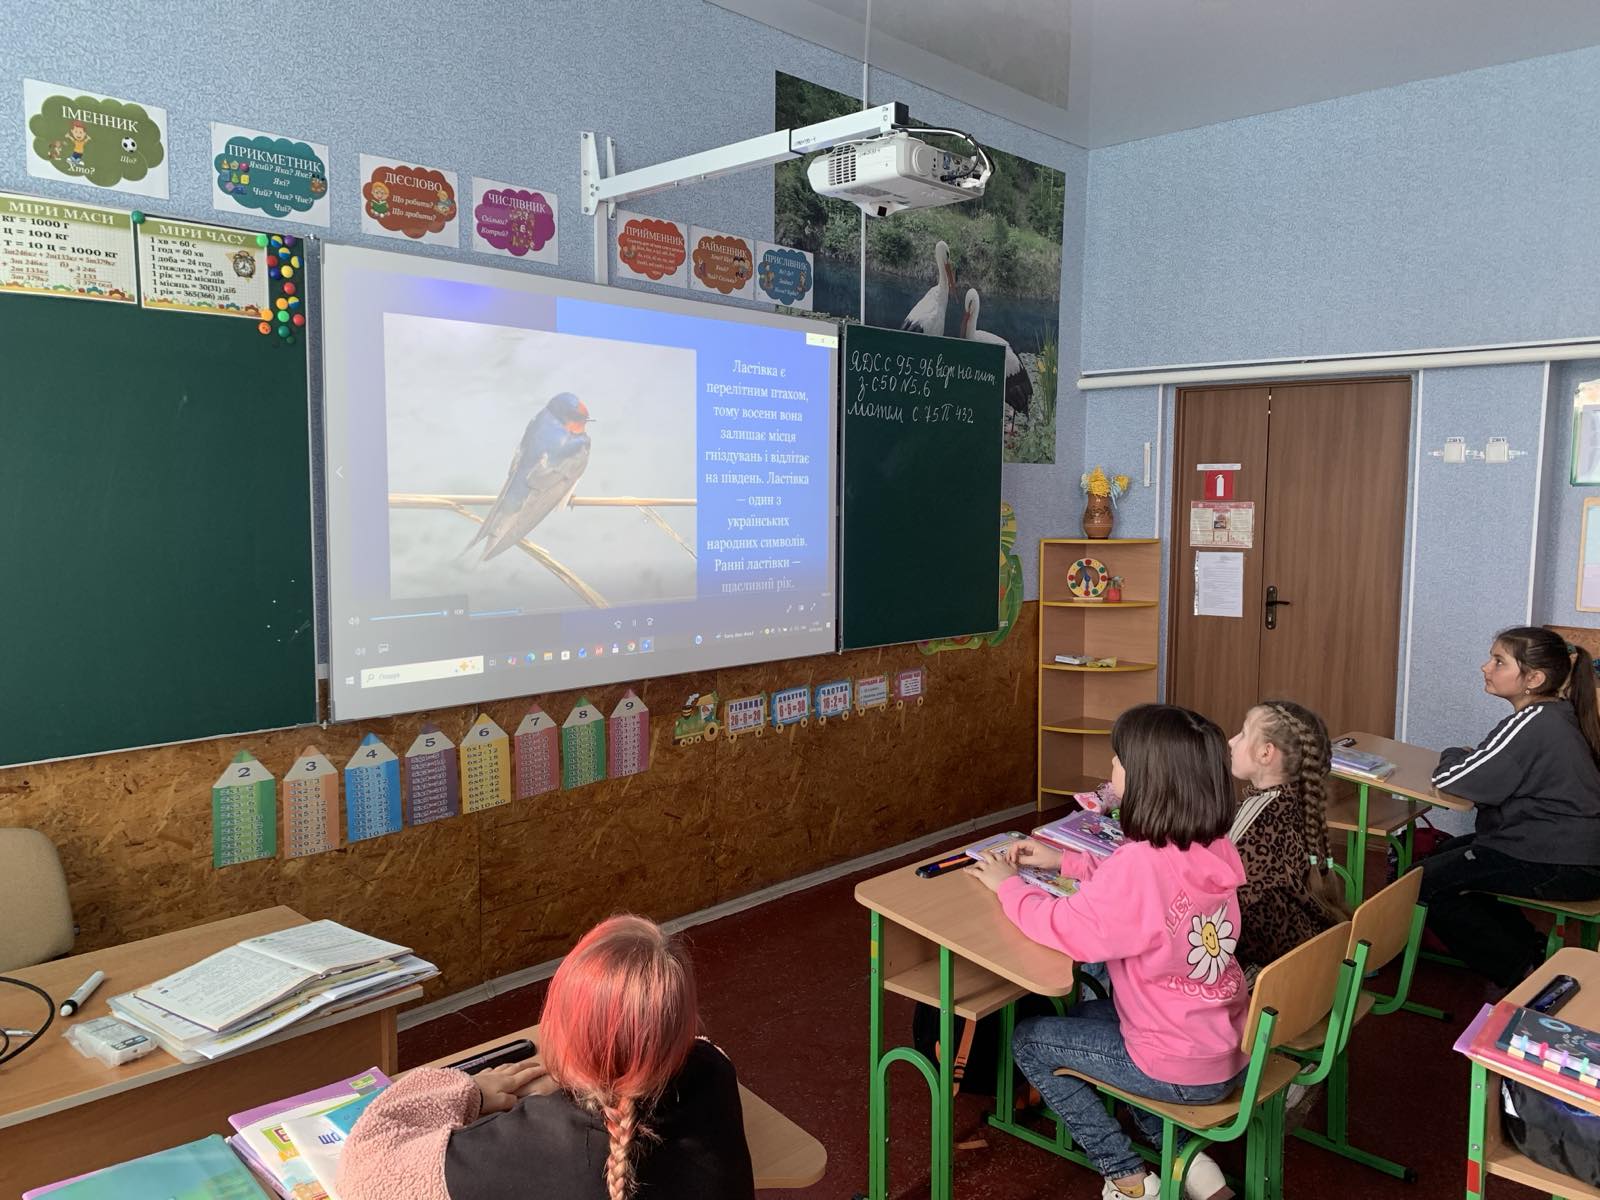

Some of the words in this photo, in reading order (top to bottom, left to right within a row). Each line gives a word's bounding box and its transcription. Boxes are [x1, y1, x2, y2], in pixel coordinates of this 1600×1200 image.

[62, 105, 138, 133] ІМЕННИК
[120, 156, 137, 164] Що?
[228, 144, 321, 173] ПРИКМЕТНИК
[68, 163, 96, 175] Хто?
[249, 160, 274, 172] Який?
[274, 166, 294, 176] Яка?
[294, 169, 312, 179] Яке?
[273, 177, 290, 186] Які?
[384, 172, 442, 192] ДІЄСЛОВО
[252, 186, 272, 198] Чий?
[488, 192, 546, 214] ЧИСЛІВНИК
[9, 201, 58, 217] МІРИ
[64, 208, 114, 225] МАСИ
[31, 218, 60, 228] 1000
[4, 228, 13, 236] ц
[28, 230, 52, 238] 100
[160, 224, 202, 239] МІРИ
[206, 231, 246, 244] ЧАСУ
[626, 226, 684, 246] ПРИЙМЕННИК
[28, 242, 43, 250] 10
[47, 244, 56, 252] ц
[72, 246, 101, 256] 1000
[150, 236, 155, 244] 1
[180, 240, 190, 248] 60
[700, 240, 748, 258] ЗАЙМЕННИК
[188, 258, 196, 266] 24
[765, 254, 808, 271] ПРИСЛІВНИК
[732, 359, 778, 376] Ластівка
[780, 366, 786, 377] є
[957, 364, 972, 380] на
[706, 381, 768, 400] перелітним
[770, 388, 808, 403] птахом,
[713, 406, 740, 420] тому
[742, 406, 778, 421] восени
[780, 410, 802, 422] вона
[720, 428, 766, 442] залишає
[768, 430, 796, 444] місця
[705, 451, 763, 466] гніздувань
[764, 452, 769, 463] і
[770, 452, 810, 466] відлітає
[706, 472, 718, 484] на
[720, 471, 765, 486] південь.
[766, 472, 810, 486] Ластівка
[748, 494, 774, 508] один
[776, 496, 782, 506] з
[727, 514, 790, 530] українських
[707, 538, 758, 553] народних
[760, 536, 808, 550] символів.
[715, 558, 744, 572] Ранні
[746, 556, 790, 571] ластівки
[722, 579, 774, 595] щасливий
[776, 577, 795, 593] рік.
[822, 685, 848, 696] ЧАСТКА
[625, 702, 634, 710] 9
[530, 716, 540, 726] 7
[579, 710, 588, 718] 8
[478, 728, 490, 737] 6
[425, 738, 436, 747] 5
[366, 750, 378, 758] 4
[238, 767, 250, 778] 2
[305, 762, 317, 772] 3
